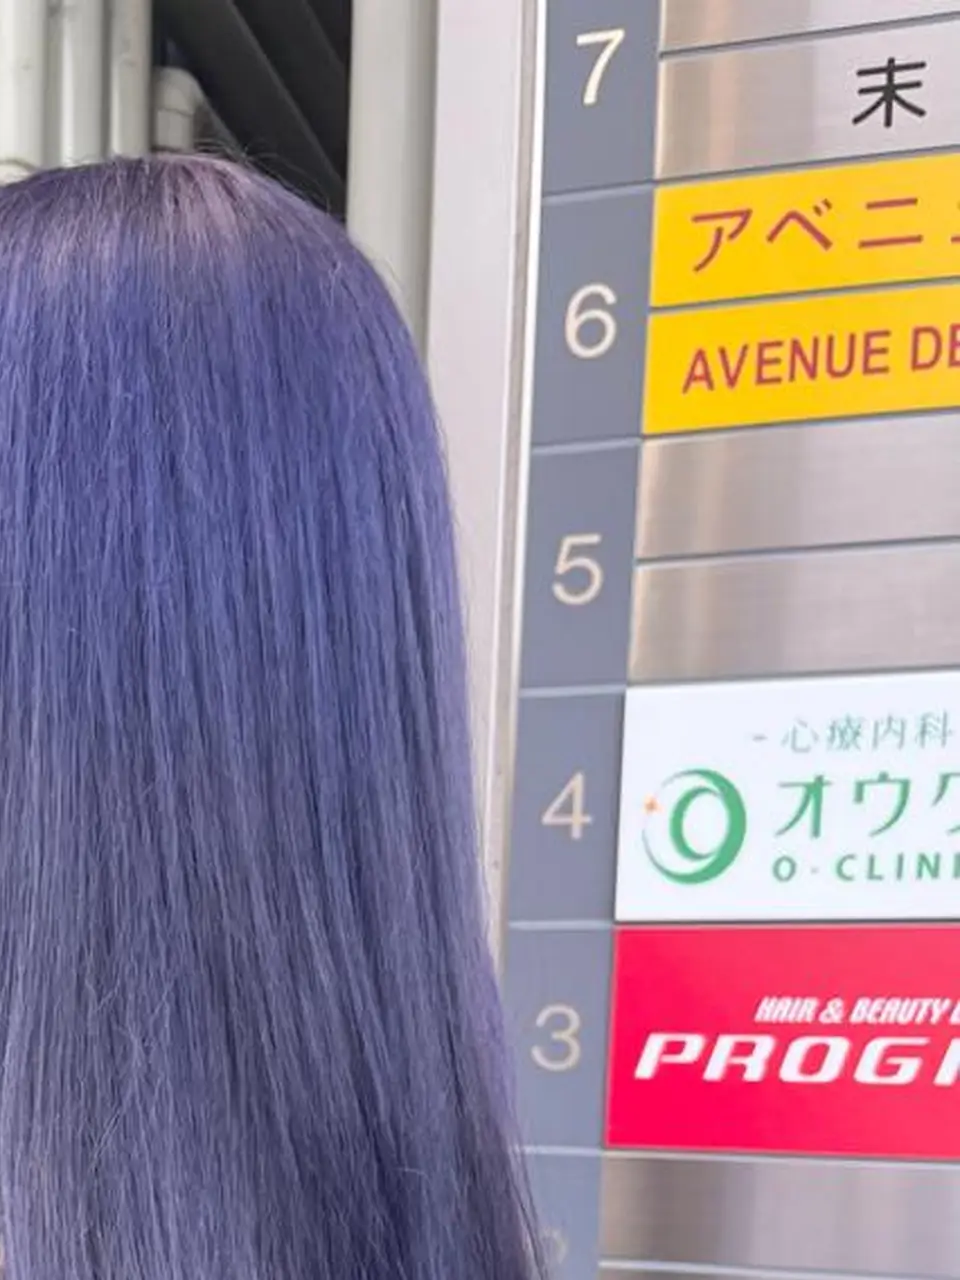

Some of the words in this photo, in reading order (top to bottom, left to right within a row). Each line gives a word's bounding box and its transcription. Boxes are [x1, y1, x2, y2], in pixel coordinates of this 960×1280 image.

[576, 29, 626, 105] 7
[691, 198, 960, 272] アベニ
[565, 283, 617, 358] 6
[683, 330, 892, 395] AVENUE
[552, 533, 604, 605] 5
[542, 771, 593, 840] 4
[531, 1005, 581, 1071] 3
[754, 996, 819, 1023] HAIR
[818, 997, 844, 1023] &
[849, 997, 951, 1025] BEAUTY
